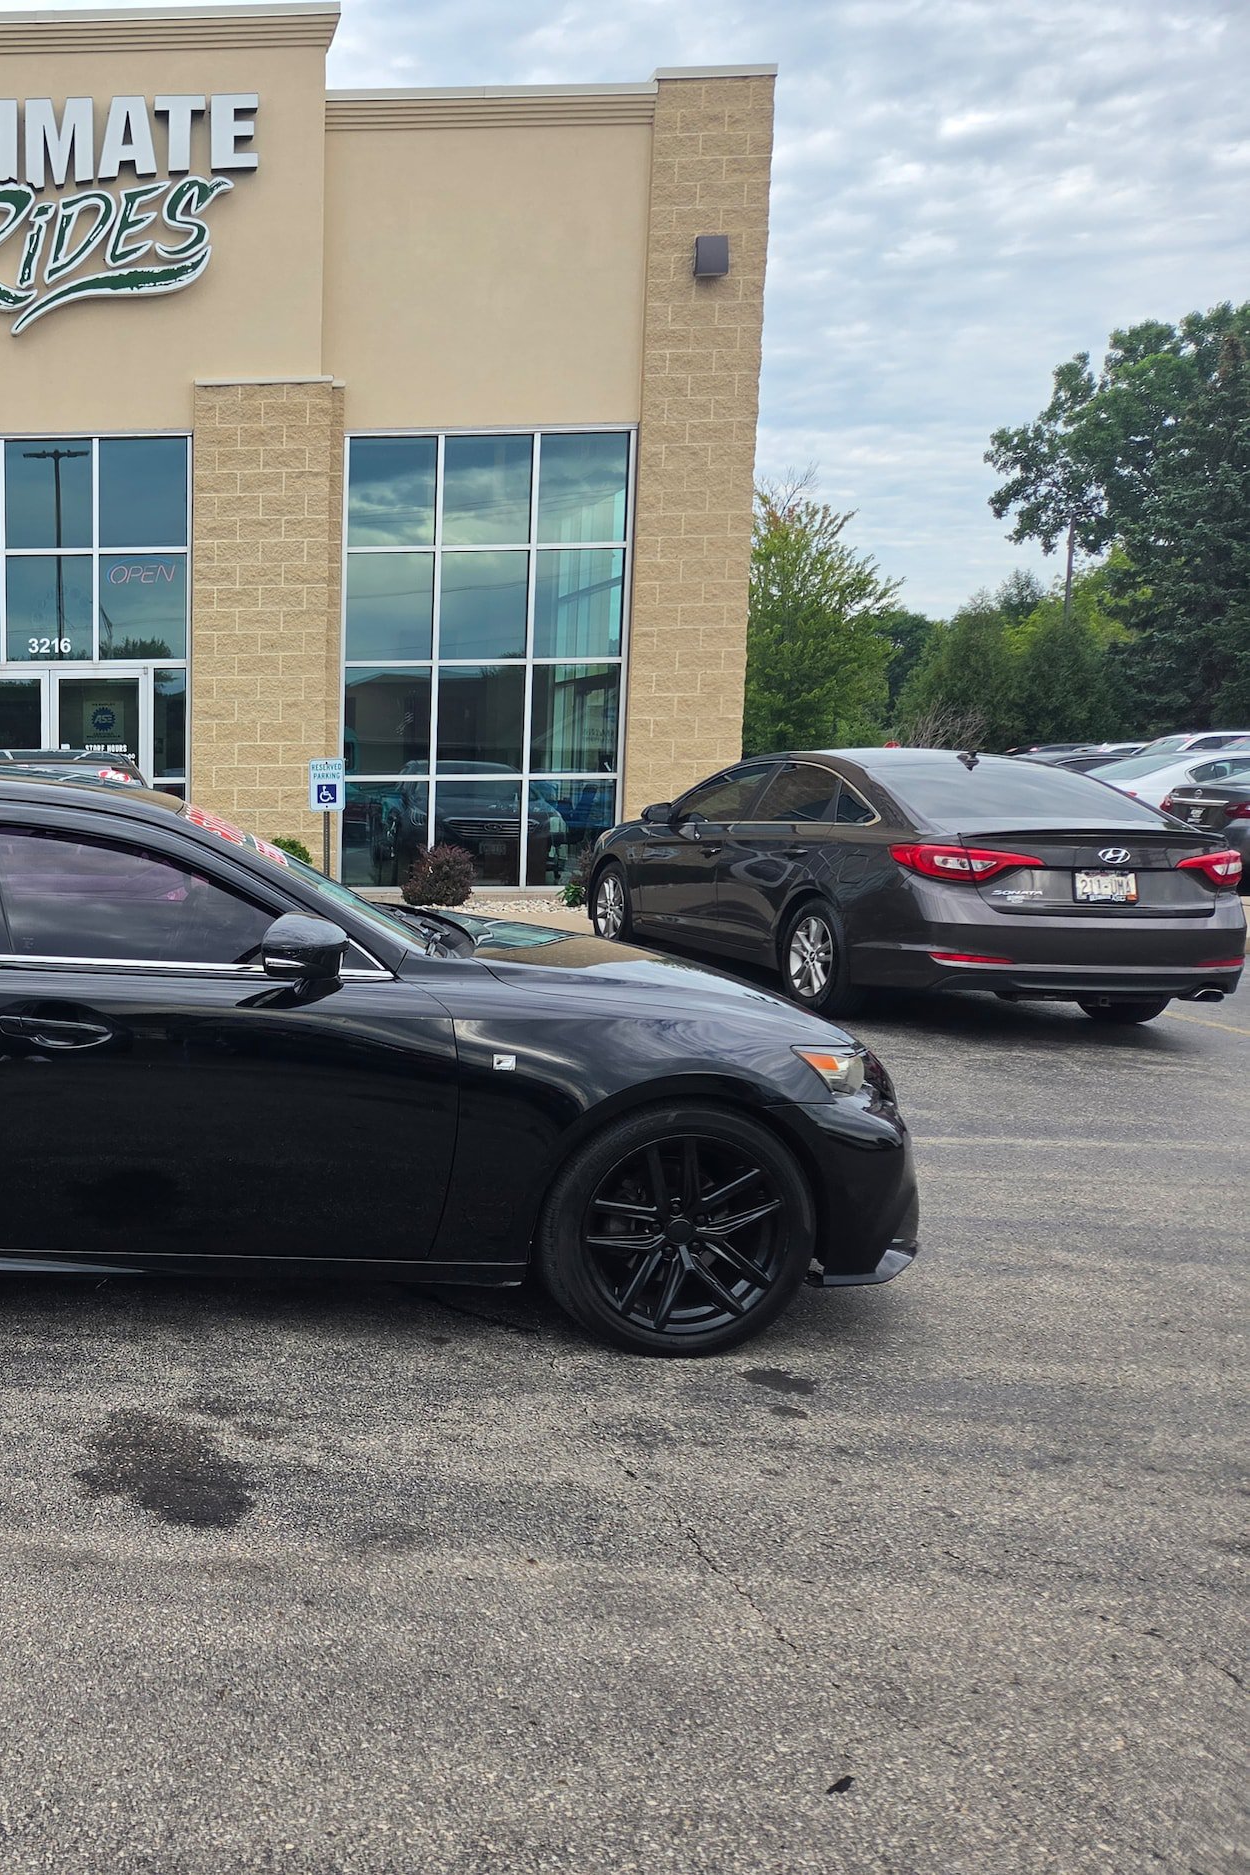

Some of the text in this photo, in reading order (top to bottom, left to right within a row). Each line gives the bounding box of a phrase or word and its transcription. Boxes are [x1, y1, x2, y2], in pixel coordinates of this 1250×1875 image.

[109, 564, 176, 584] OPEN
[27, 637, 72, 654] 3216
[93, 714, 114, 724] ASE
[106, 744, 128, 753] HOURS
[311, 763, 342, 771] RESERVED
[313, 772, 341, 780] PARKING
